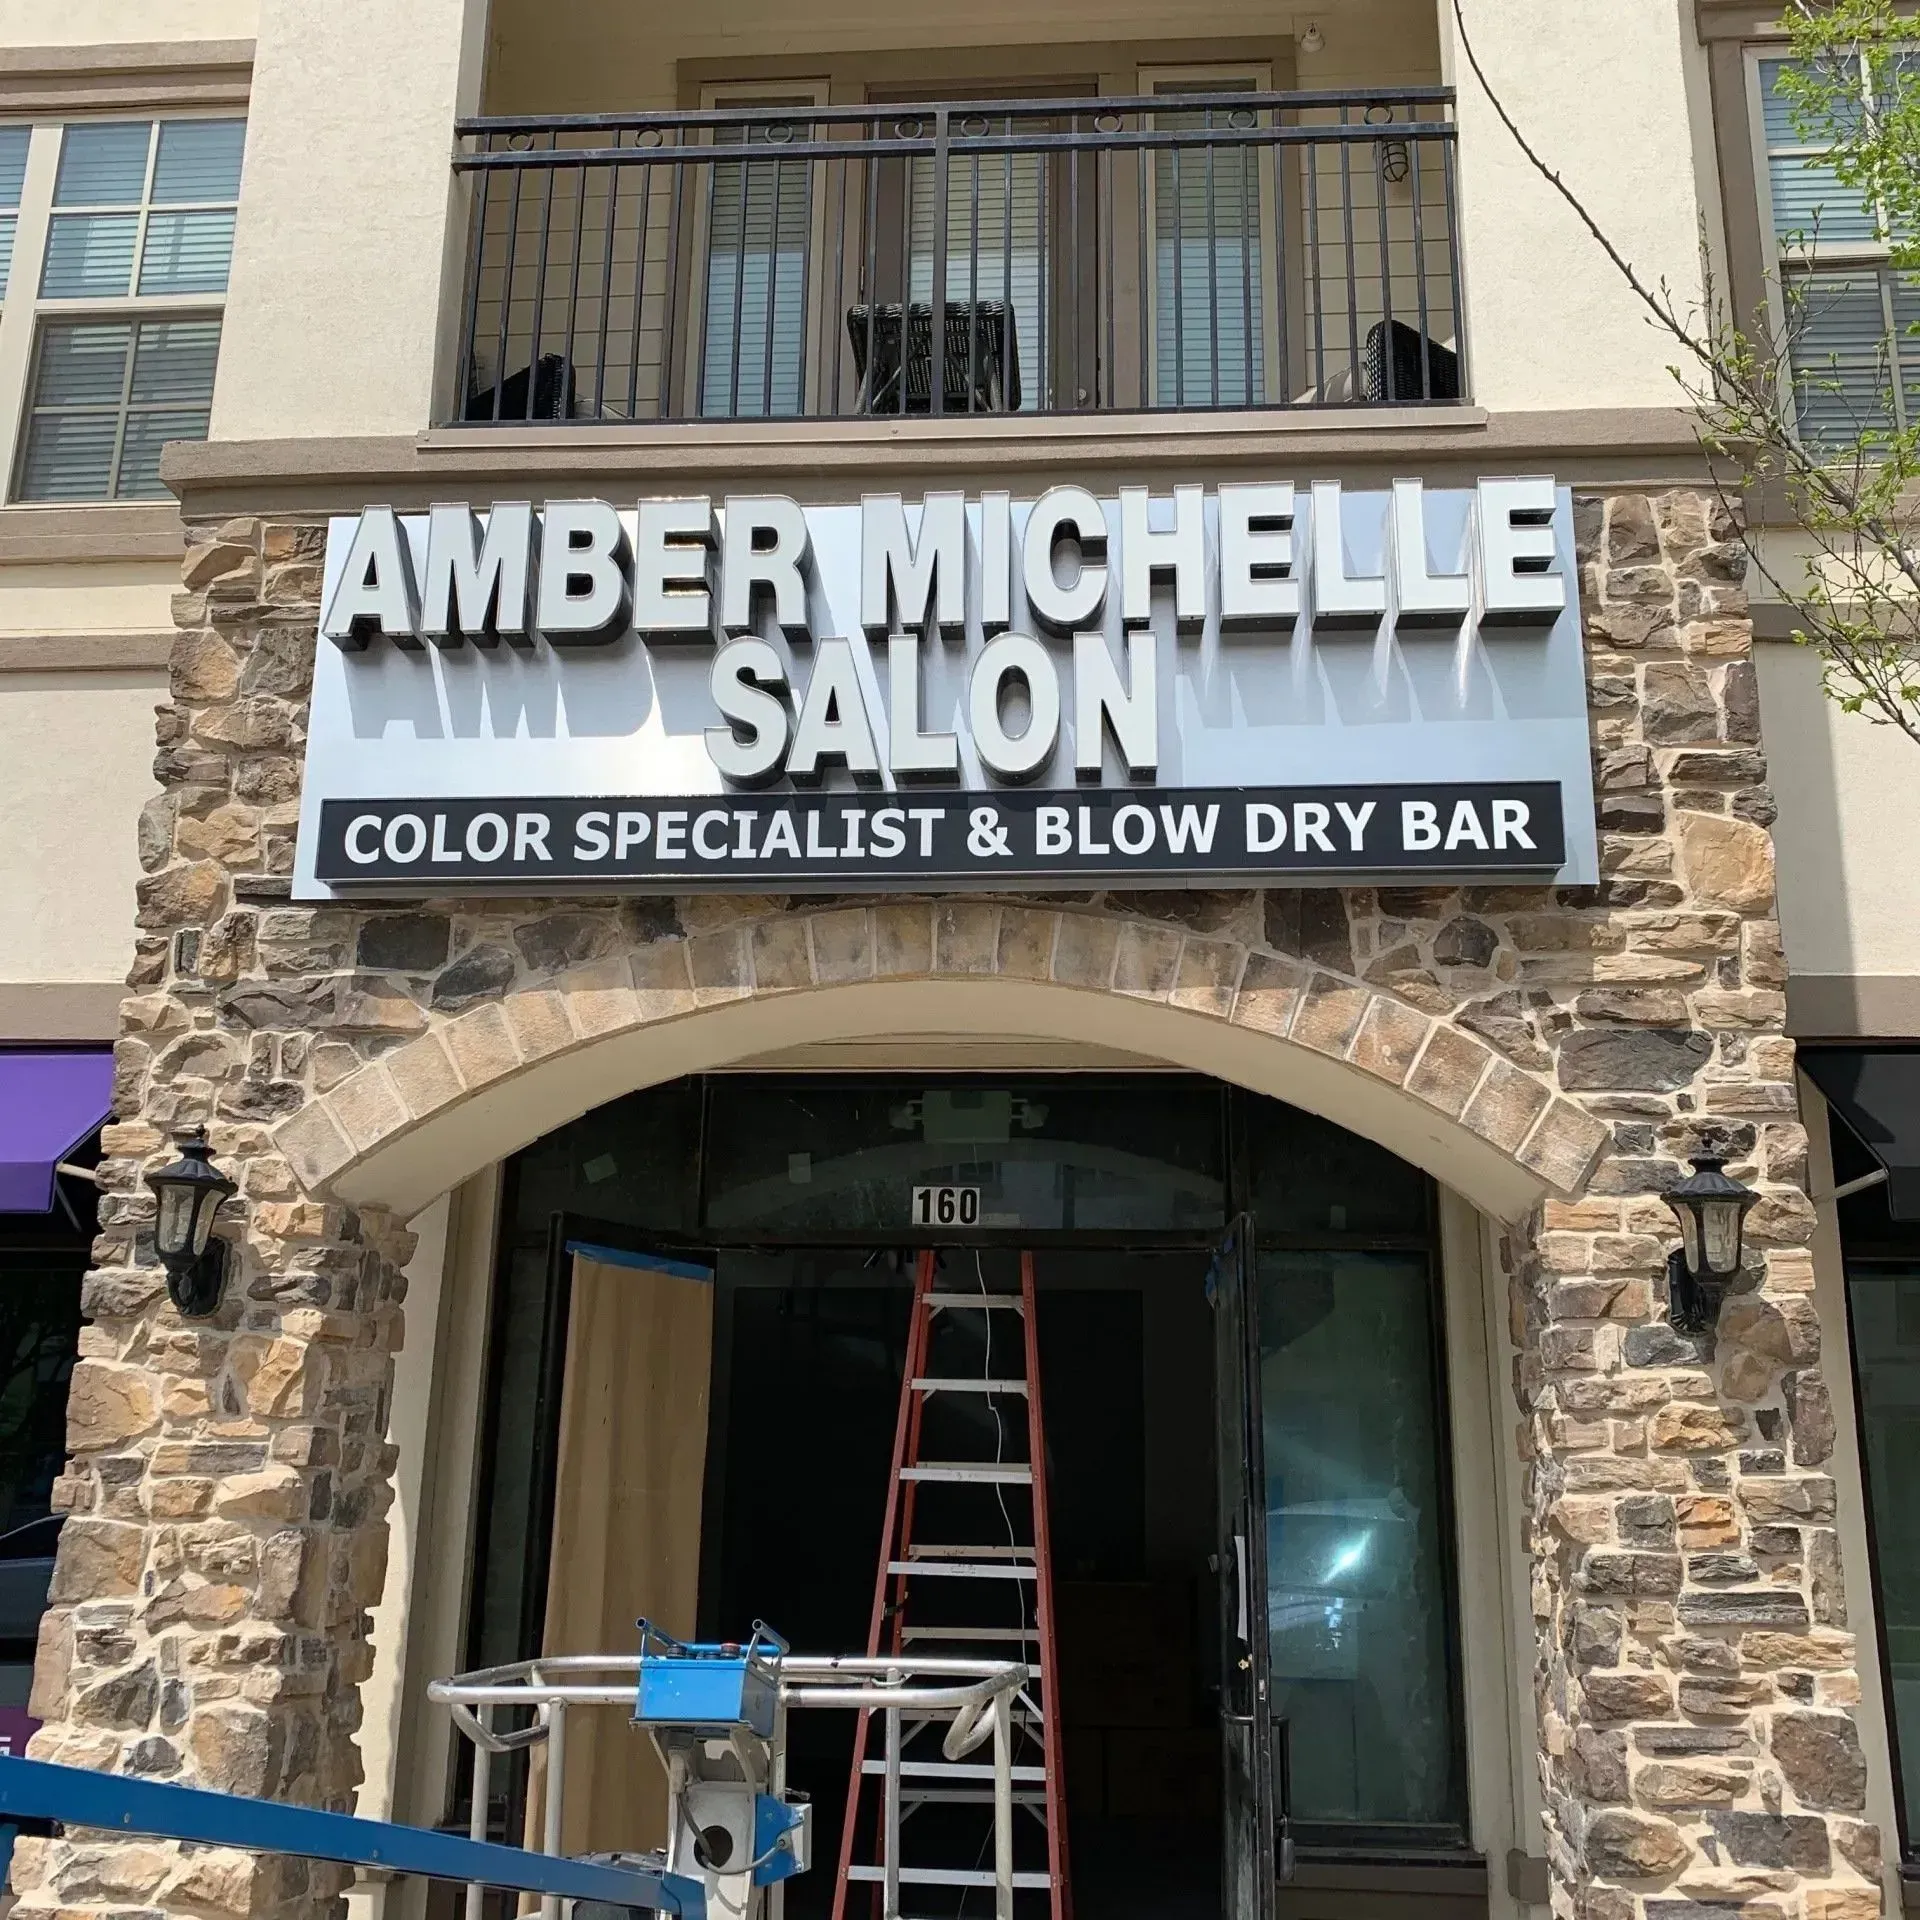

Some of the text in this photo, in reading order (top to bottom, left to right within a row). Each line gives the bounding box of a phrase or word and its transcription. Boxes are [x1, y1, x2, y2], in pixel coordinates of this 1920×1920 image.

[322, 474, 1566, 640] AMBER MICHELLE
[704, 631, 1158, 778] SALON
[344, 798, 1538, 865] COLOR SPECIALIST & BLOW DRY BAR
[918, 1188, 978, 1224] 160
